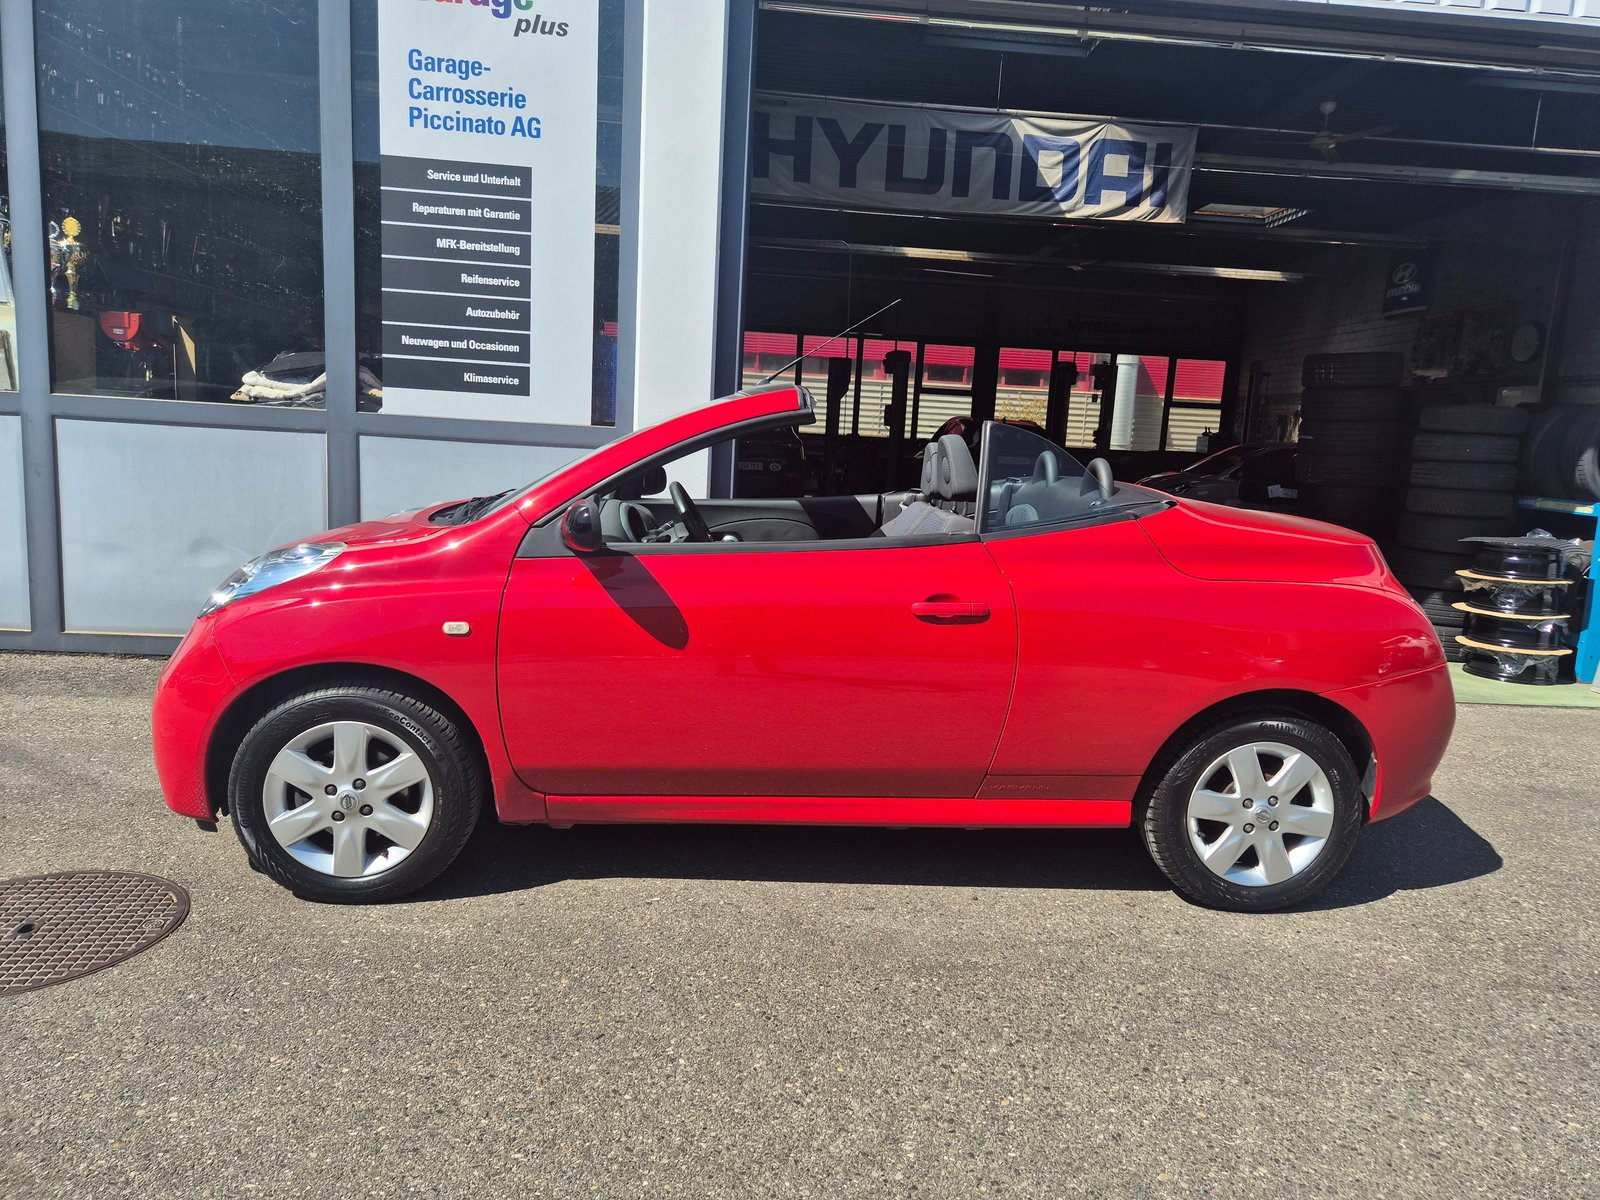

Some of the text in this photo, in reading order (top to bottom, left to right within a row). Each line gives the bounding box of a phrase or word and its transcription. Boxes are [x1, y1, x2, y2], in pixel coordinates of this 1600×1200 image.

[513, 14, 570, 38] plus
[408, 48, 491, 81] Garage-
[408, 77, 527, 109] Carrosserie
[408, 106, 541, 139] Piccinato AG
[426, 169, 521, 187] Service und Unterhalt
[412, 202, 521, 220] Reparaturen mit Garantie
[436, 238, 521, 256] MFK-Bereitstellung
[460, 273, 521, 287] Reifenservice
[465, 306, 521, 320] Autozubehör
[401, 334, 520, 353] Neuwagen und Occasionen
[463, 372, 520, 386] Klimaservice
